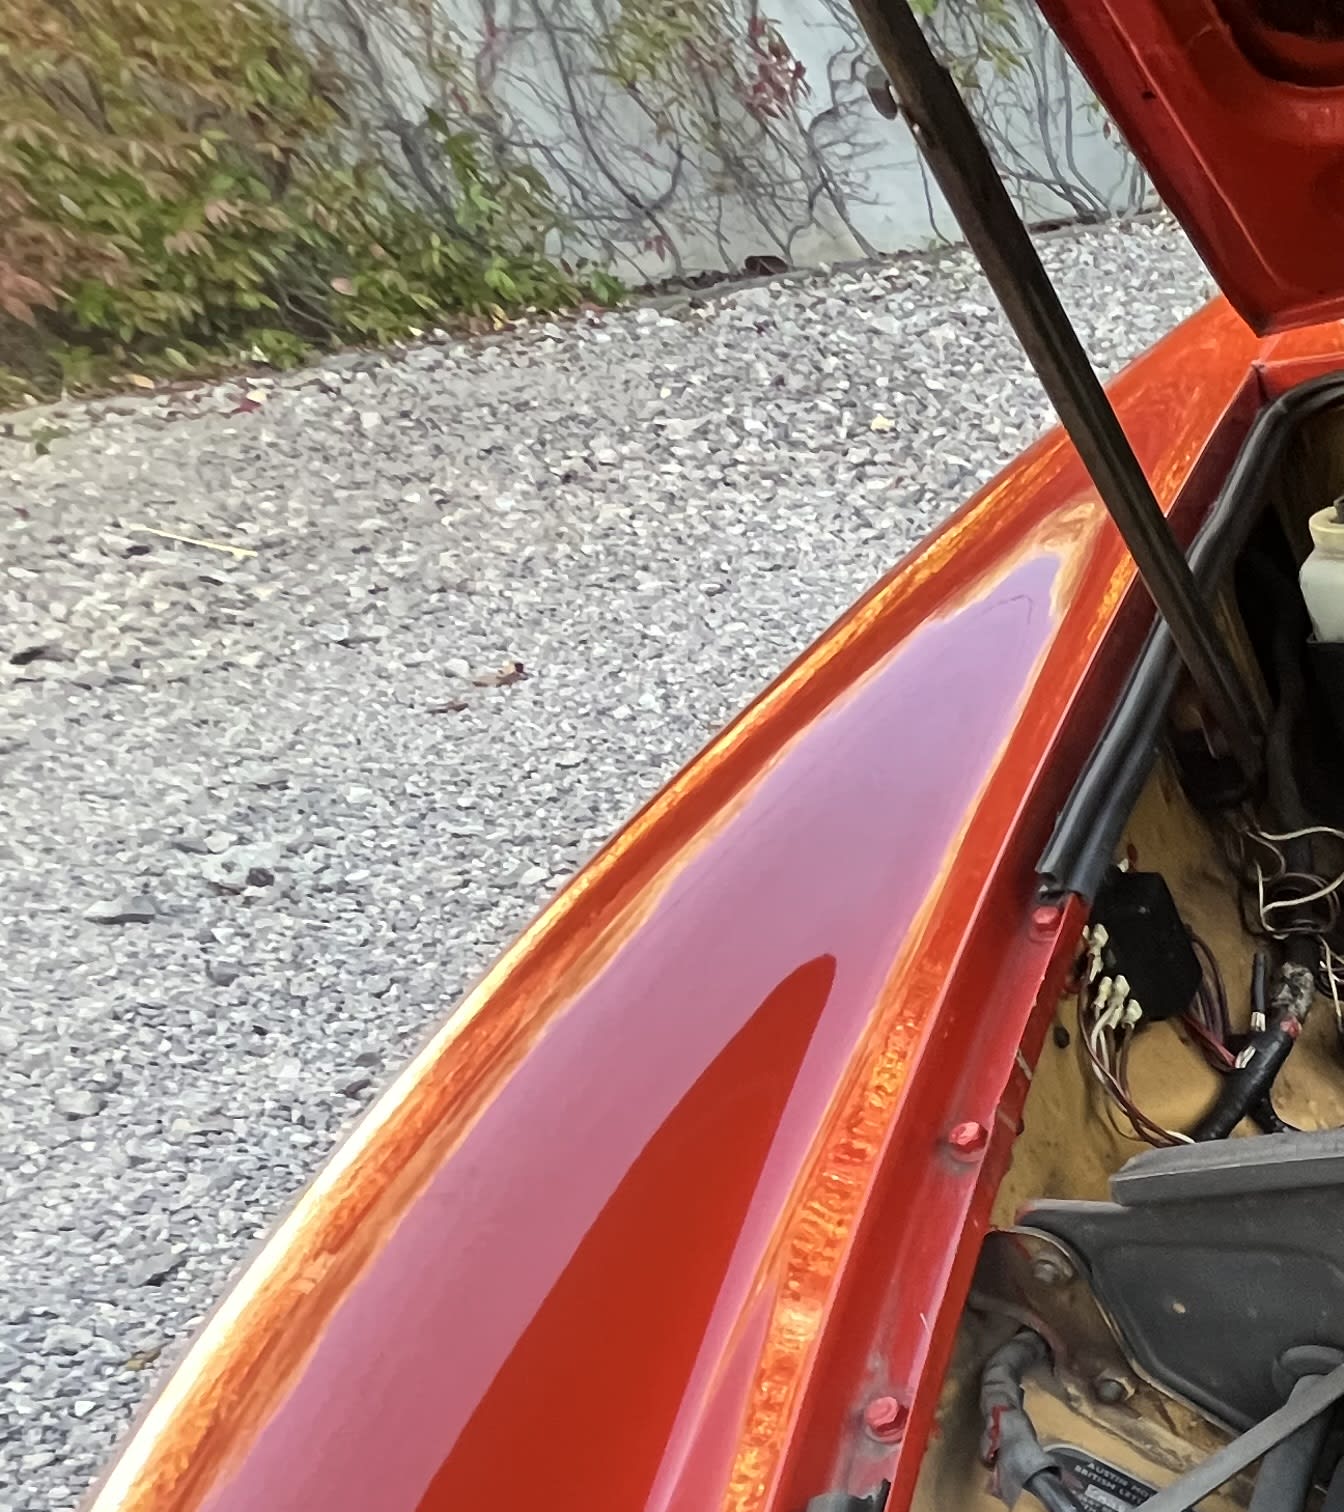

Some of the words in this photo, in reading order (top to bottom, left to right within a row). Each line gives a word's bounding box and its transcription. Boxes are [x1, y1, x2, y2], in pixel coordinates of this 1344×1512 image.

[1074, 1465, 1116, 1490] BRITISH
[1087, 1462, 1129, 1487] AUSTIN
[1131, 1485, 1150, 1498] MO
